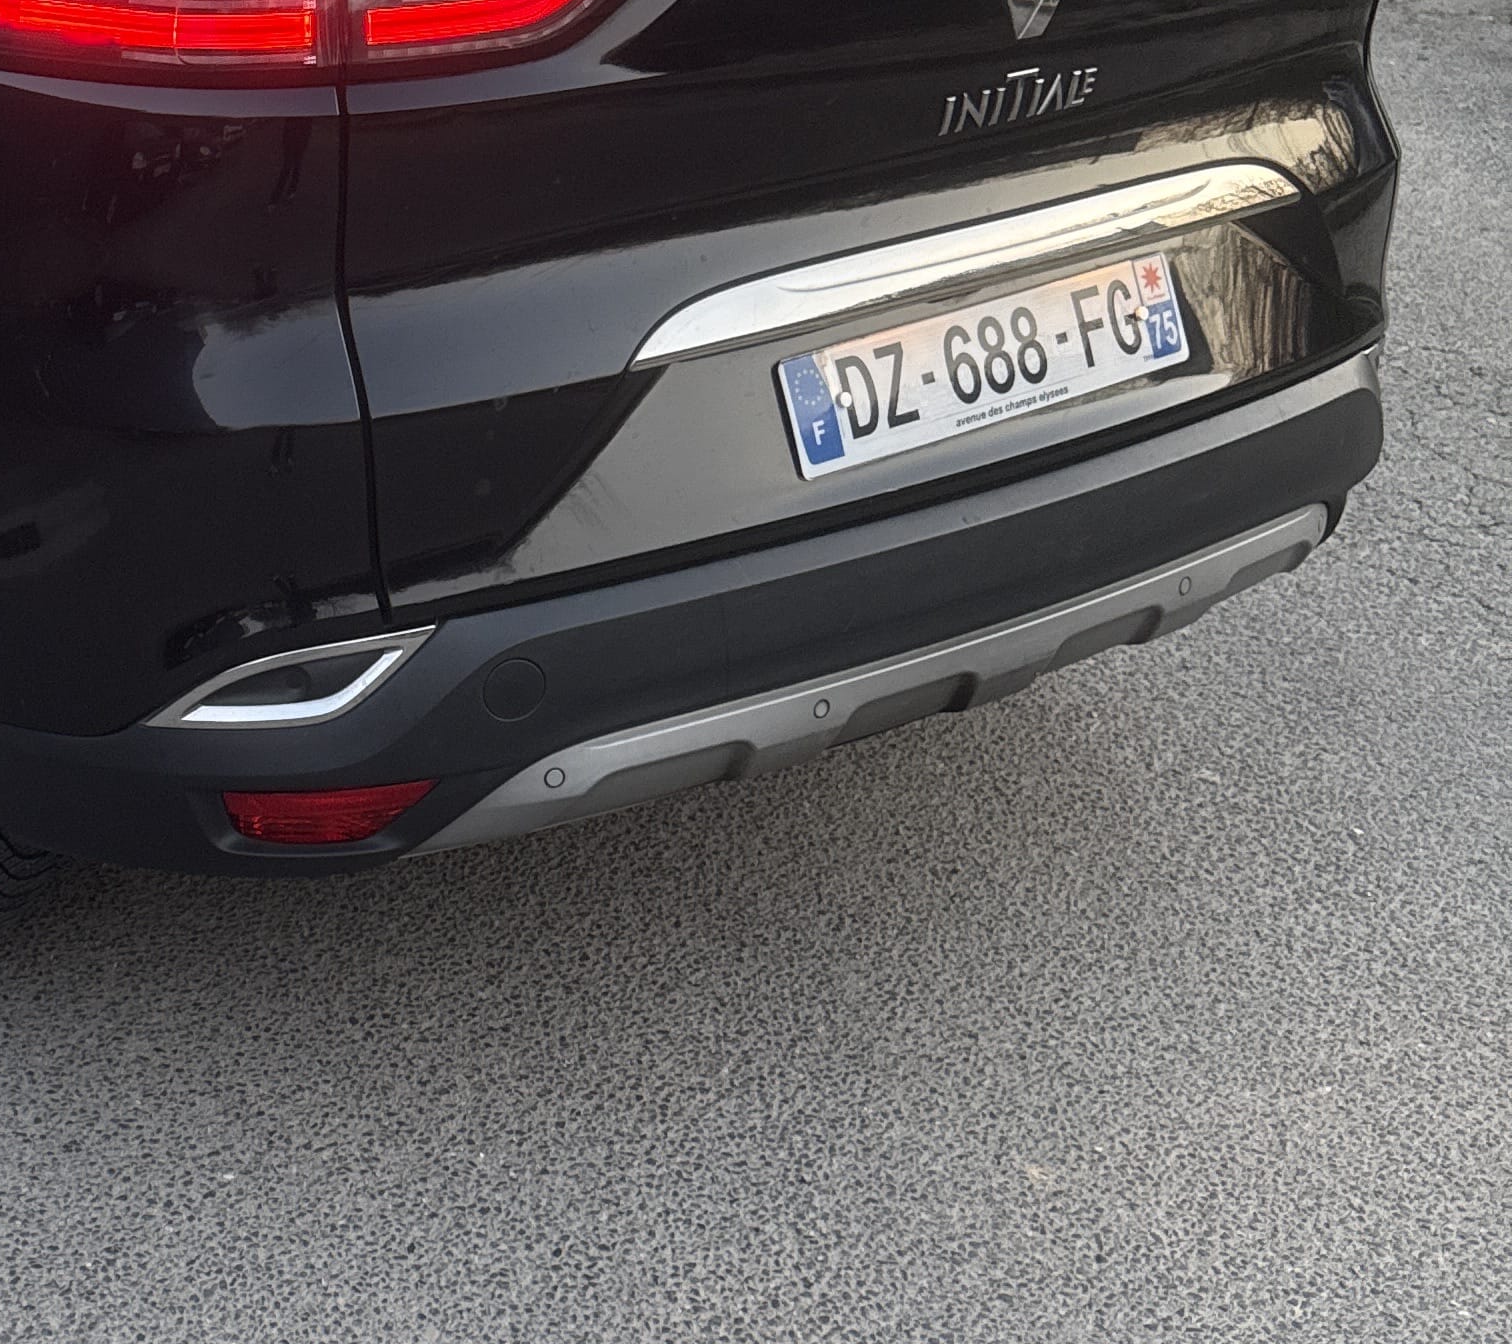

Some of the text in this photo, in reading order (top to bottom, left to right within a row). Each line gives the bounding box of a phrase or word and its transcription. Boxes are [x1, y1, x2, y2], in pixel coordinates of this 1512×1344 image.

[938, 67, 1098, 137] INITIALE
[812, 279, 1178, 446] F DZ-688-FG 75
[956, 411, 987, 427] avenue
[988, 406, 1004, 417] des
[1005, 395, 1037, 412] champs
